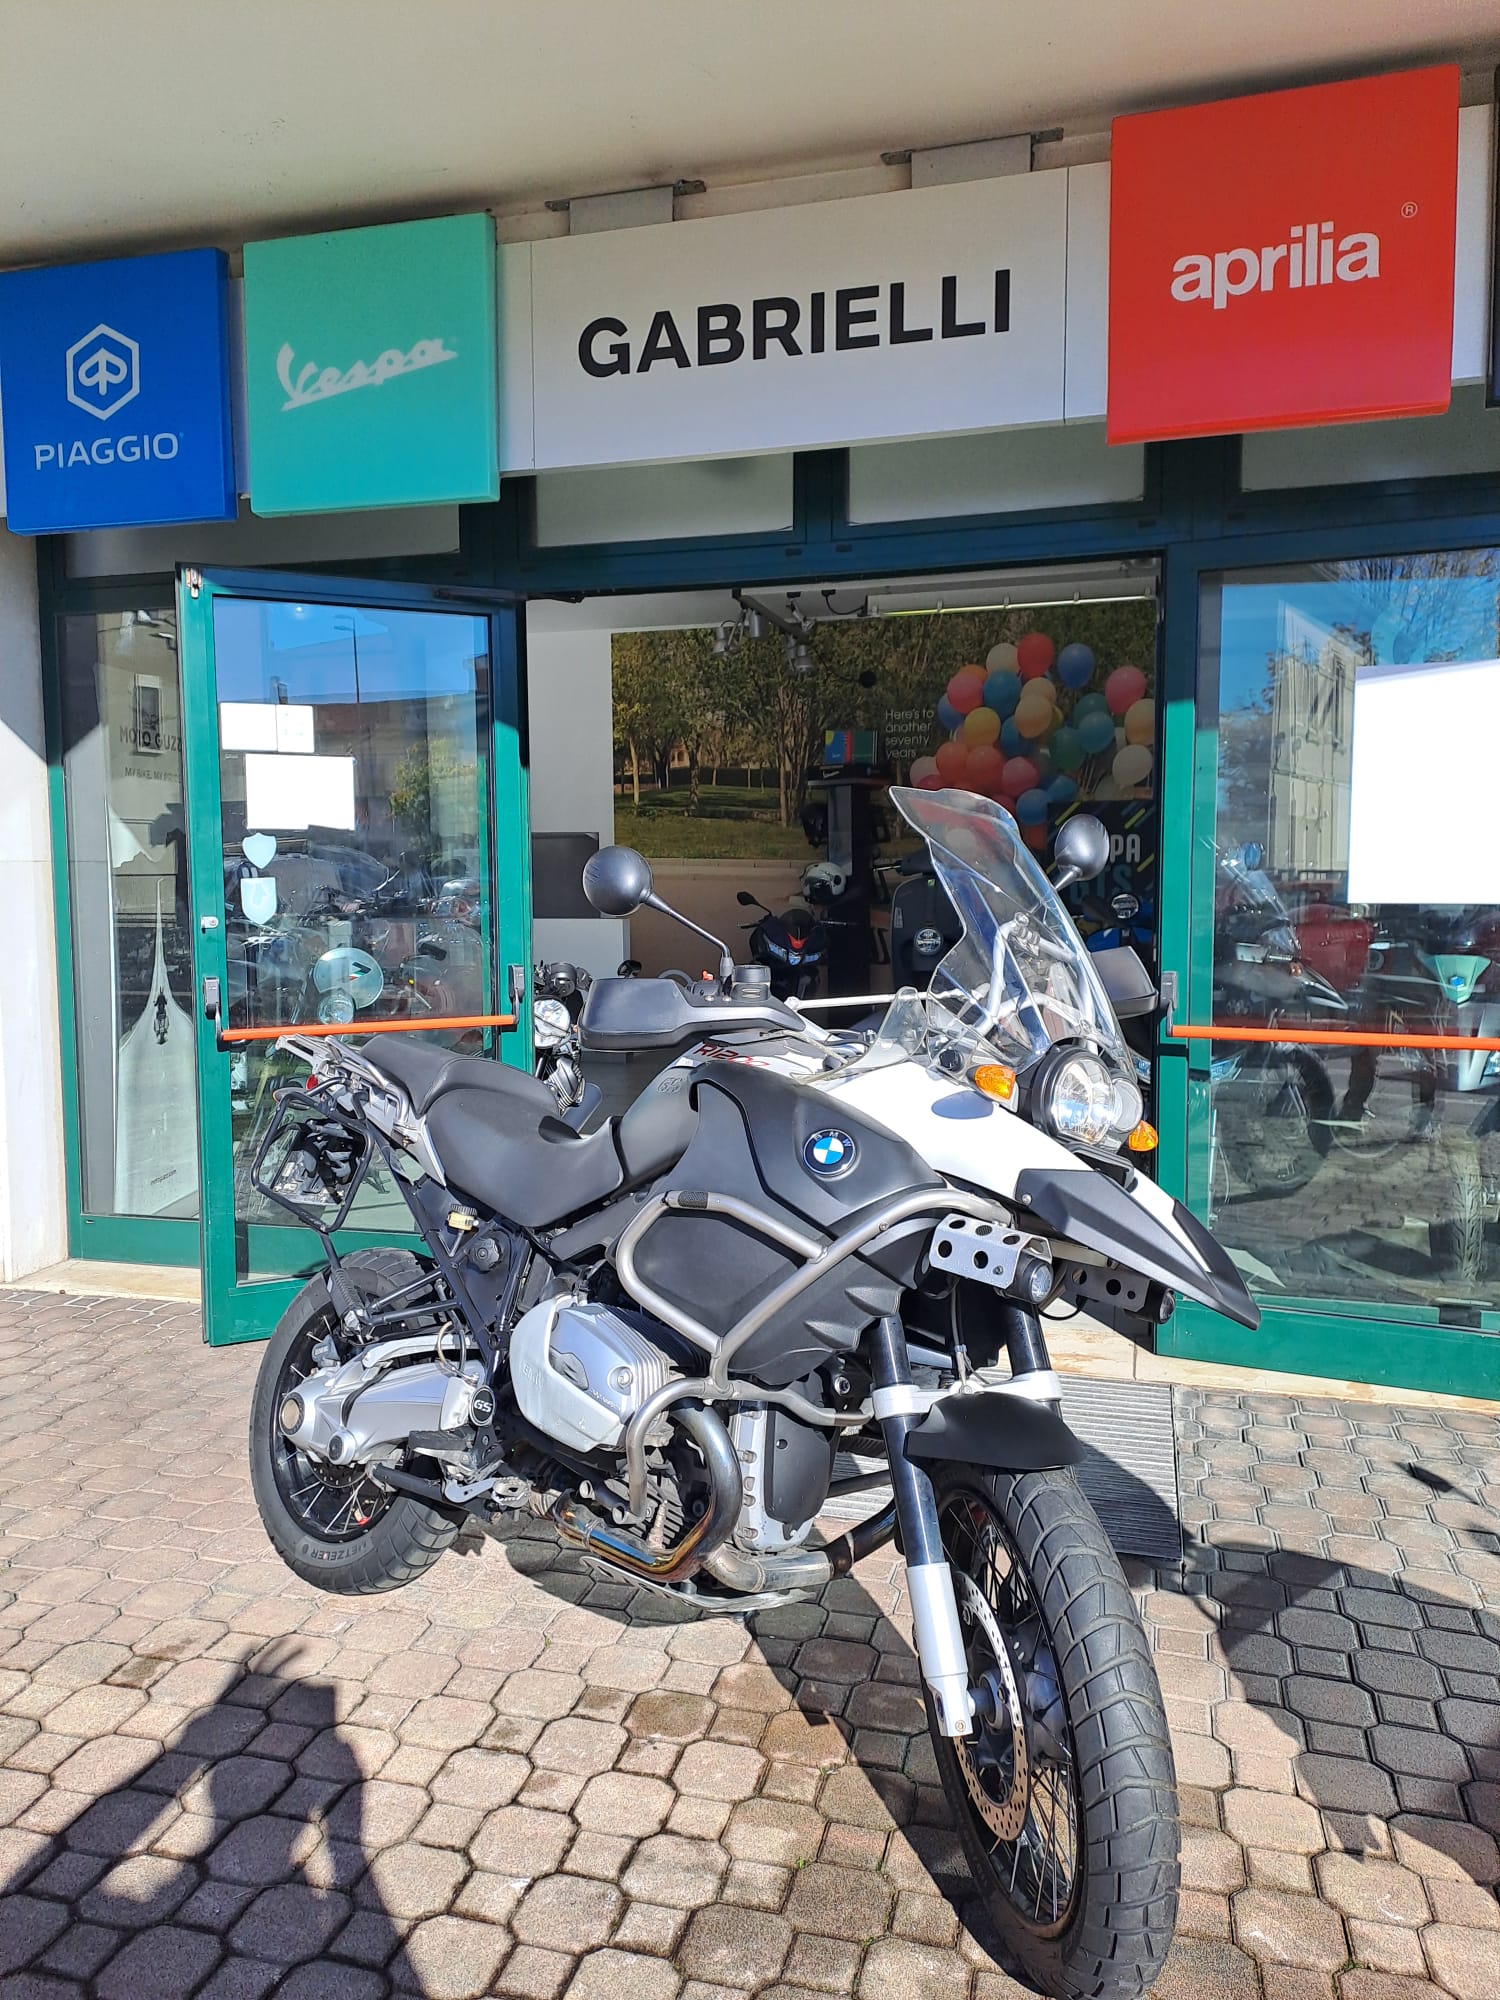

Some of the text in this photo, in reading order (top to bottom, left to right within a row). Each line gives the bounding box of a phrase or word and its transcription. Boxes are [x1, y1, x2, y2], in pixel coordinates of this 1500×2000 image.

[1170, 221, 1381, 310] aprilia
[578, 268, 1011, 378] GABRIELLI
[276, 341, 459, 412] Vespa
[34, 432, 179, 471] PIAGGIO
[885, 707, 935, 720] Here's to
[885, 720, 932, 733] another
[885, 734, 930, 746] seventy
[813, 1131, 853, 1147] BMW
[473, 1399, 493, 1413] GS
